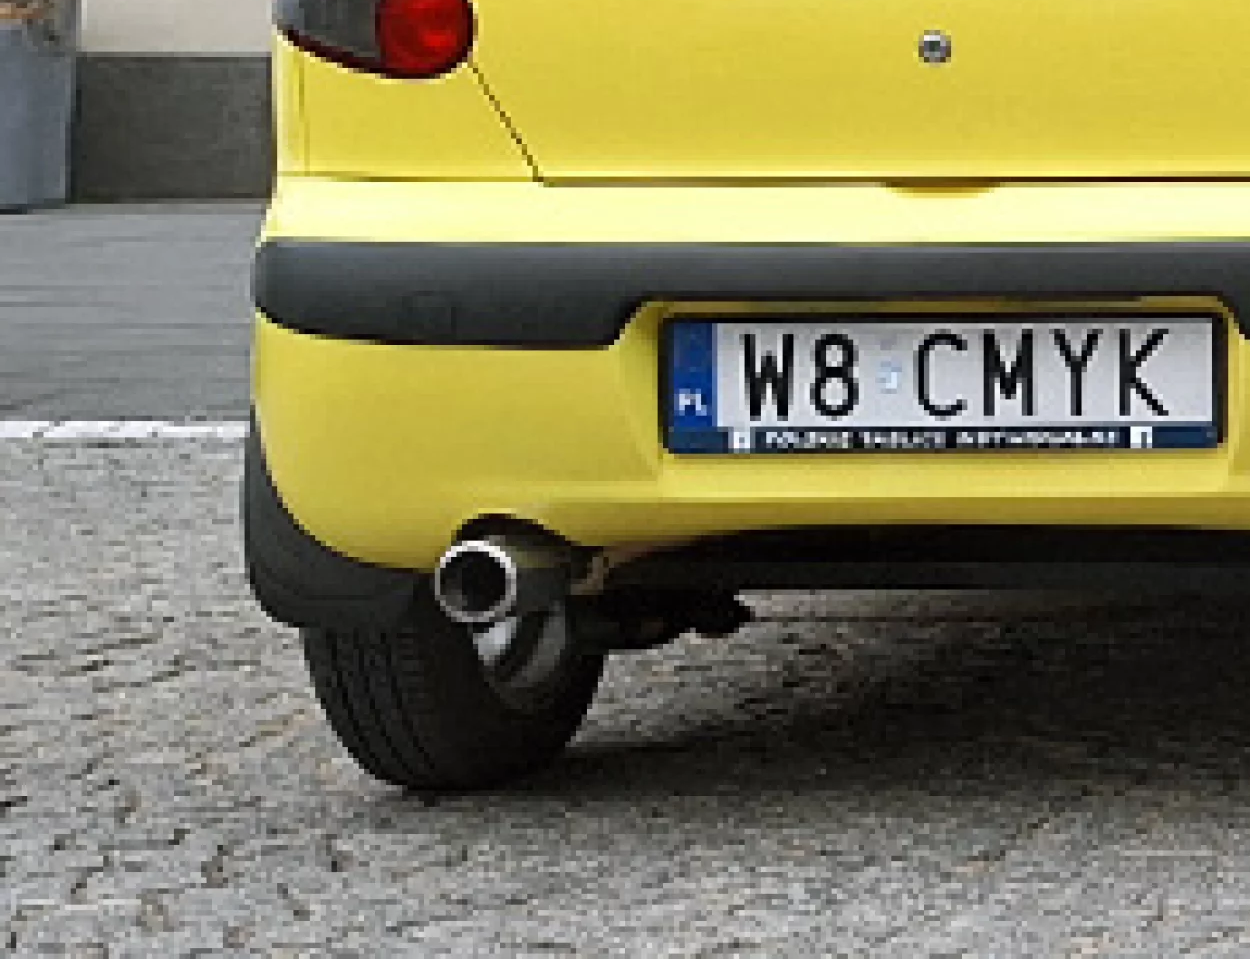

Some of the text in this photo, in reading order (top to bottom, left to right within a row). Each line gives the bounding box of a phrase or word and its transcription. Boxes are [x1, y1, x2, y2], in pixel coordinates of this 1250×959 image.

[678, 389, 708, 416] PL
[742, 328, 1170, 421] W8 CMYK
